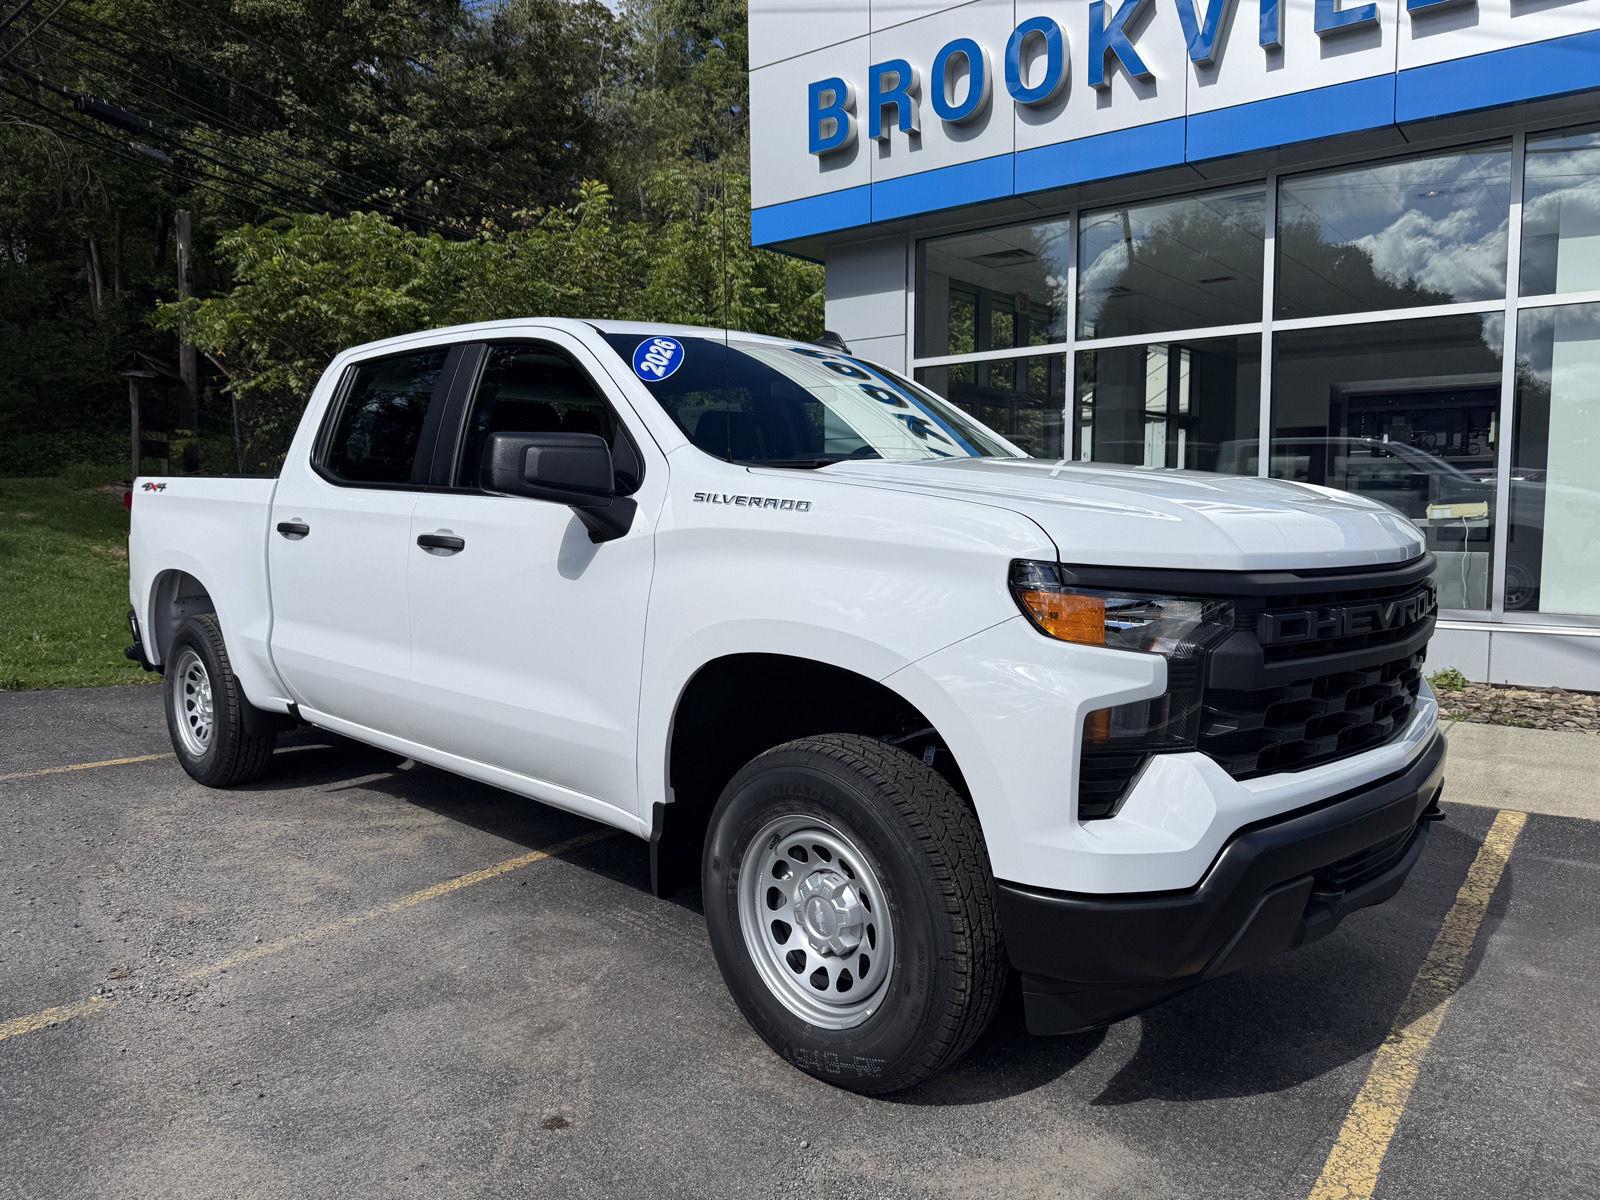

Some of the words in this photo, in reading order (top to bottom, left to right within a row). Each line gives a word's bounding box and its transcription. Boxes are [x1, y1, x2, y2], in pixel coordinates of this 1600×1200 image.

[808, 0, 1458, 156] BROOKV
[640, 338, 677, 378] 2026
[693, 492, 812, 512] SILVERADO
